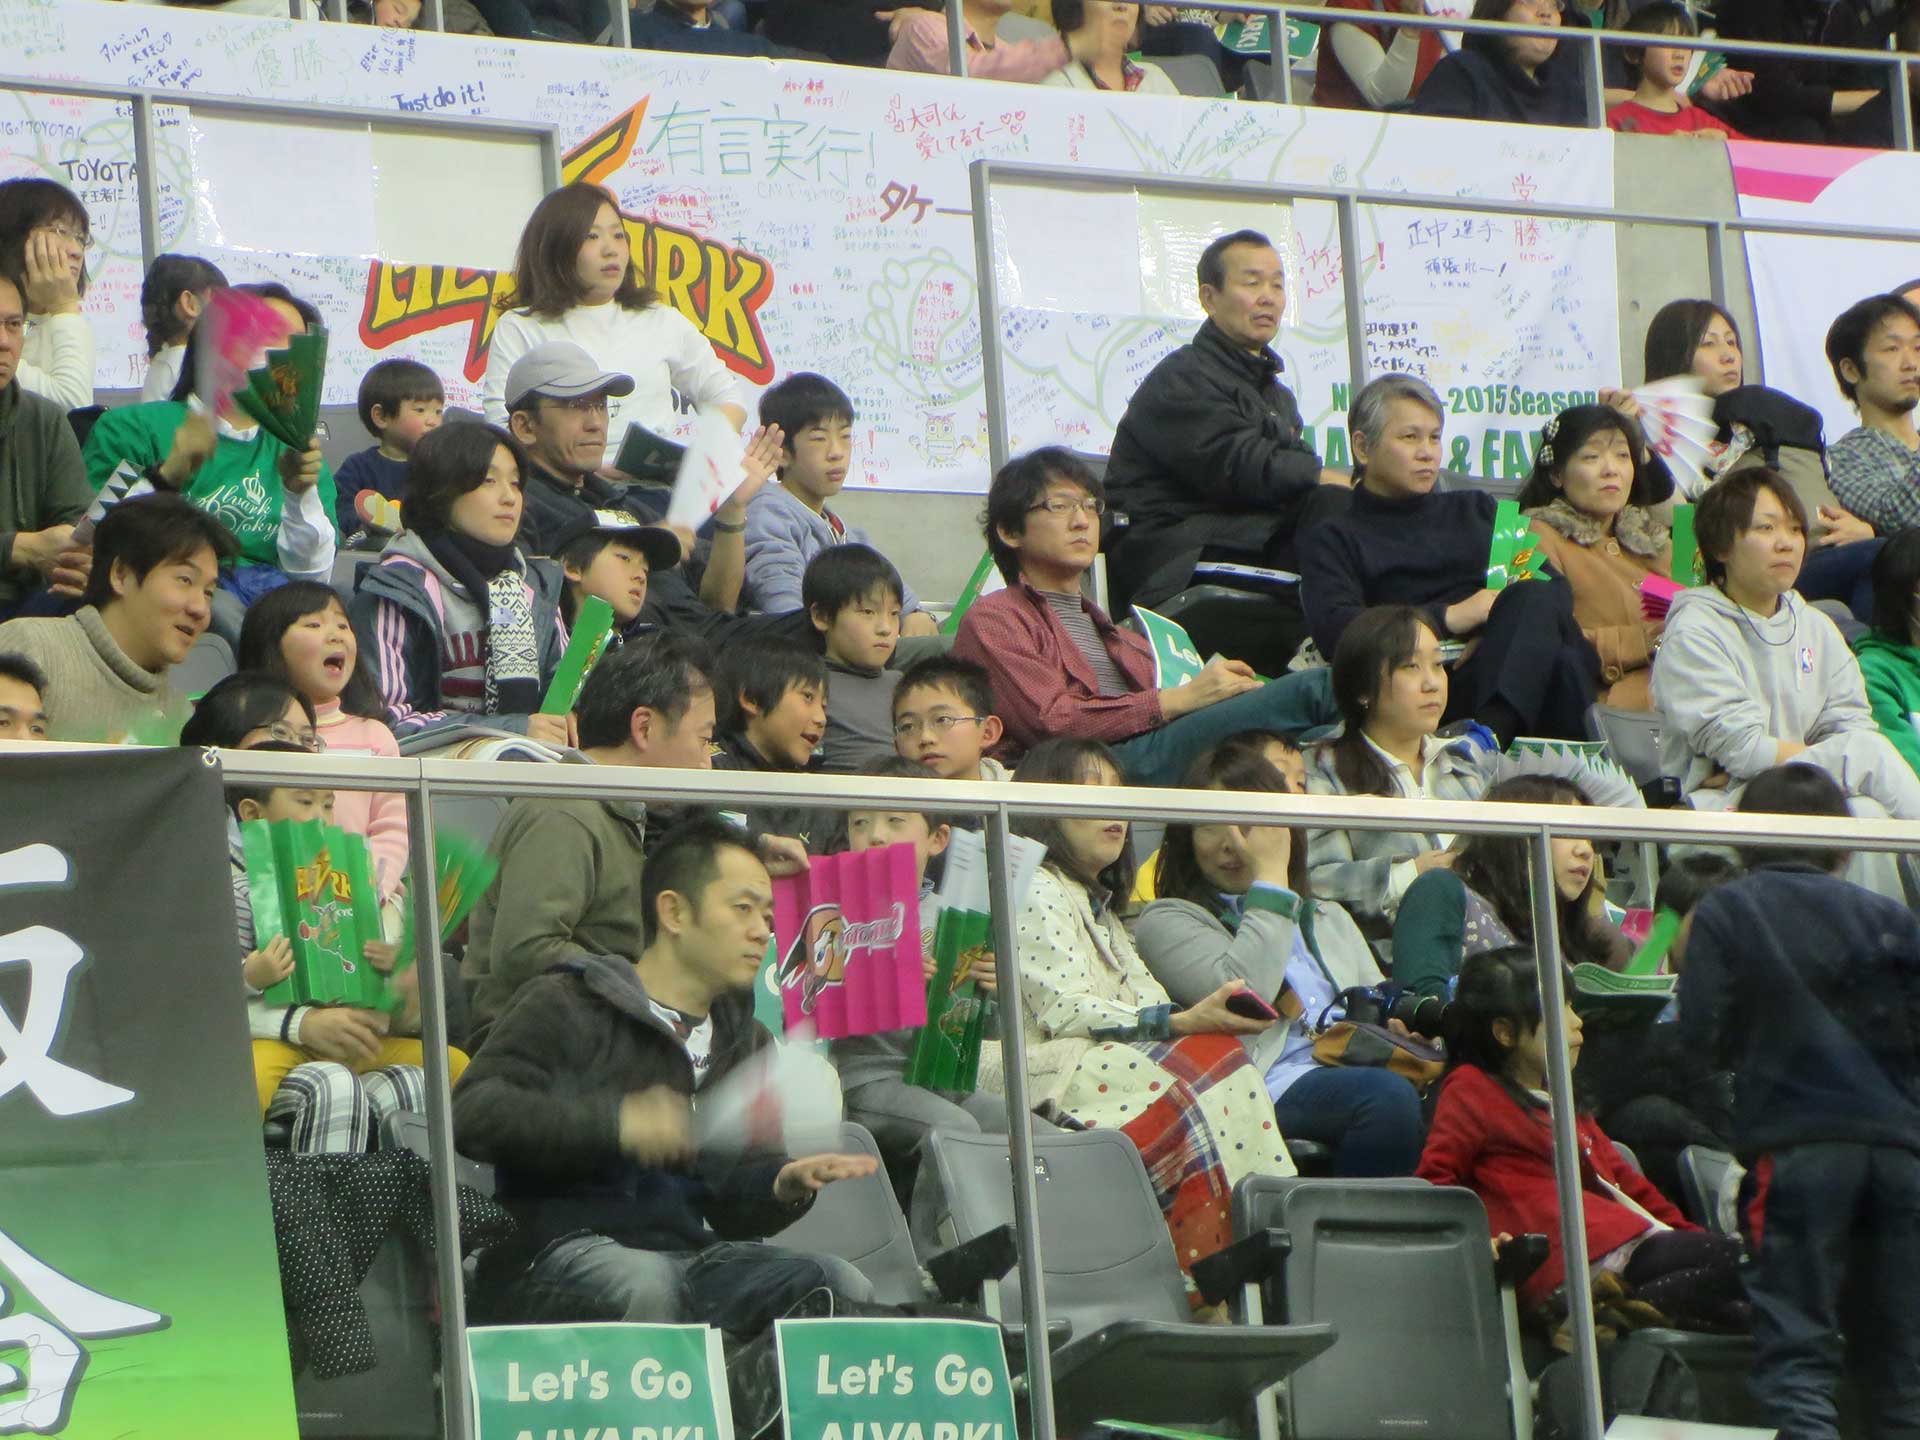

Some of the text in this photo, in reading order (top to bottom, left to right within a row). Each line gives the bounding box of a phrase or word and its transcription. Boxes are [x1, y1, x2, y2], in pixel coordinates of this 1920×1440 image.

[432, 85, 456, 108] do
[459, 80, 486, 105] it!
[508, 1357, 693, 1402] Let's Go
[817, 1353, 994, 1396] Let's Go
